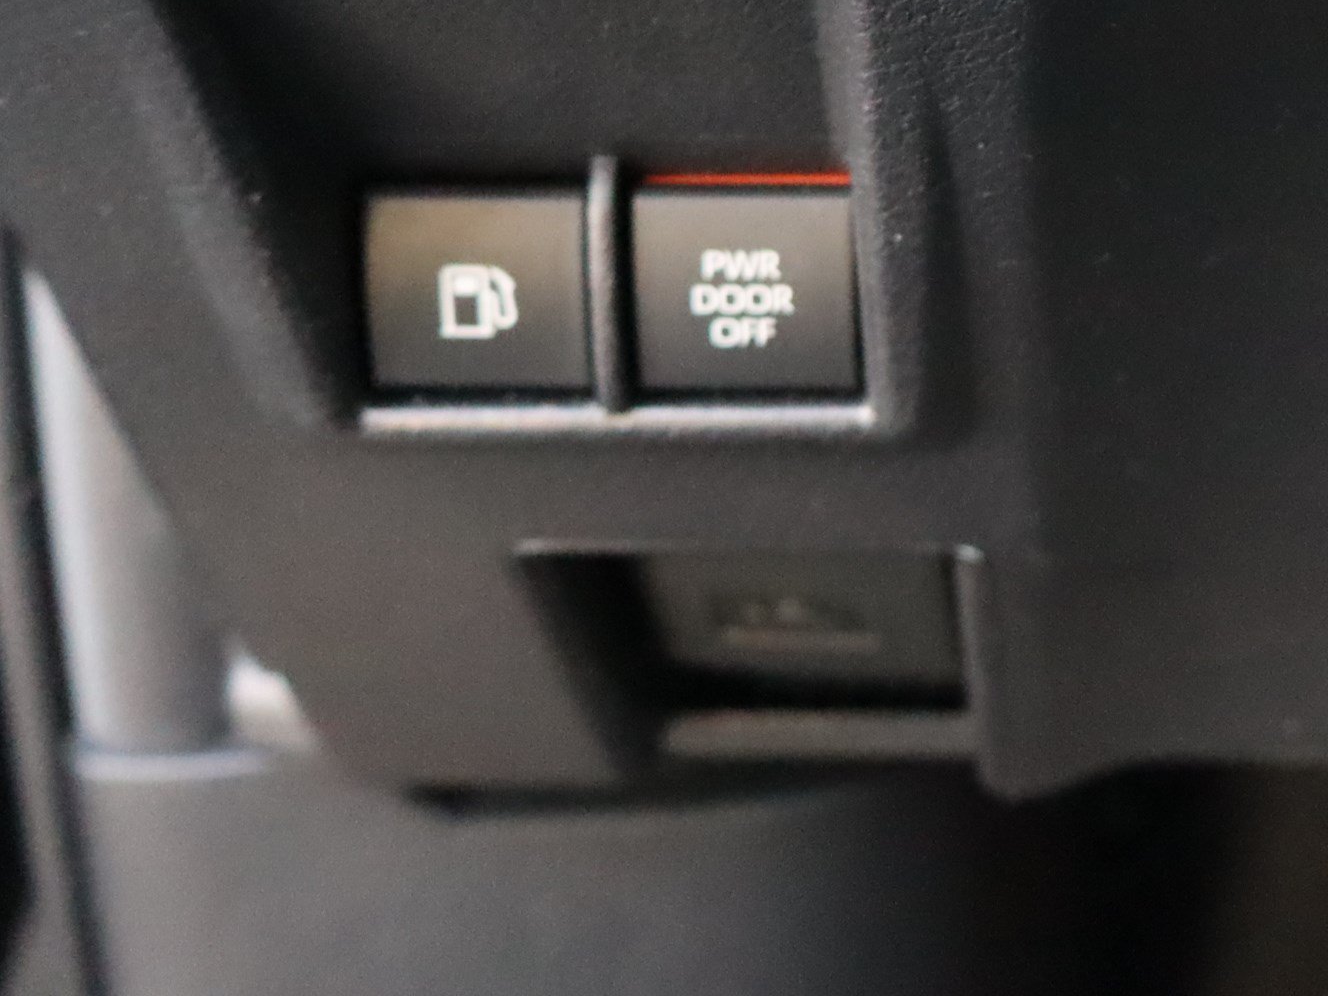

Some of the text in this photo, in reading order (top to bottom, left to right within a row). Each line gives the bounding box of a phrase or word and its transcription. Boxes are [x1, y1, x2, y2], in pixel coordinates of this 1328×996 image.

[701, 248, 782, 282] PWR
[689, 283, 795, 317] DOOR
[708, 317, 777, 349] OFF
